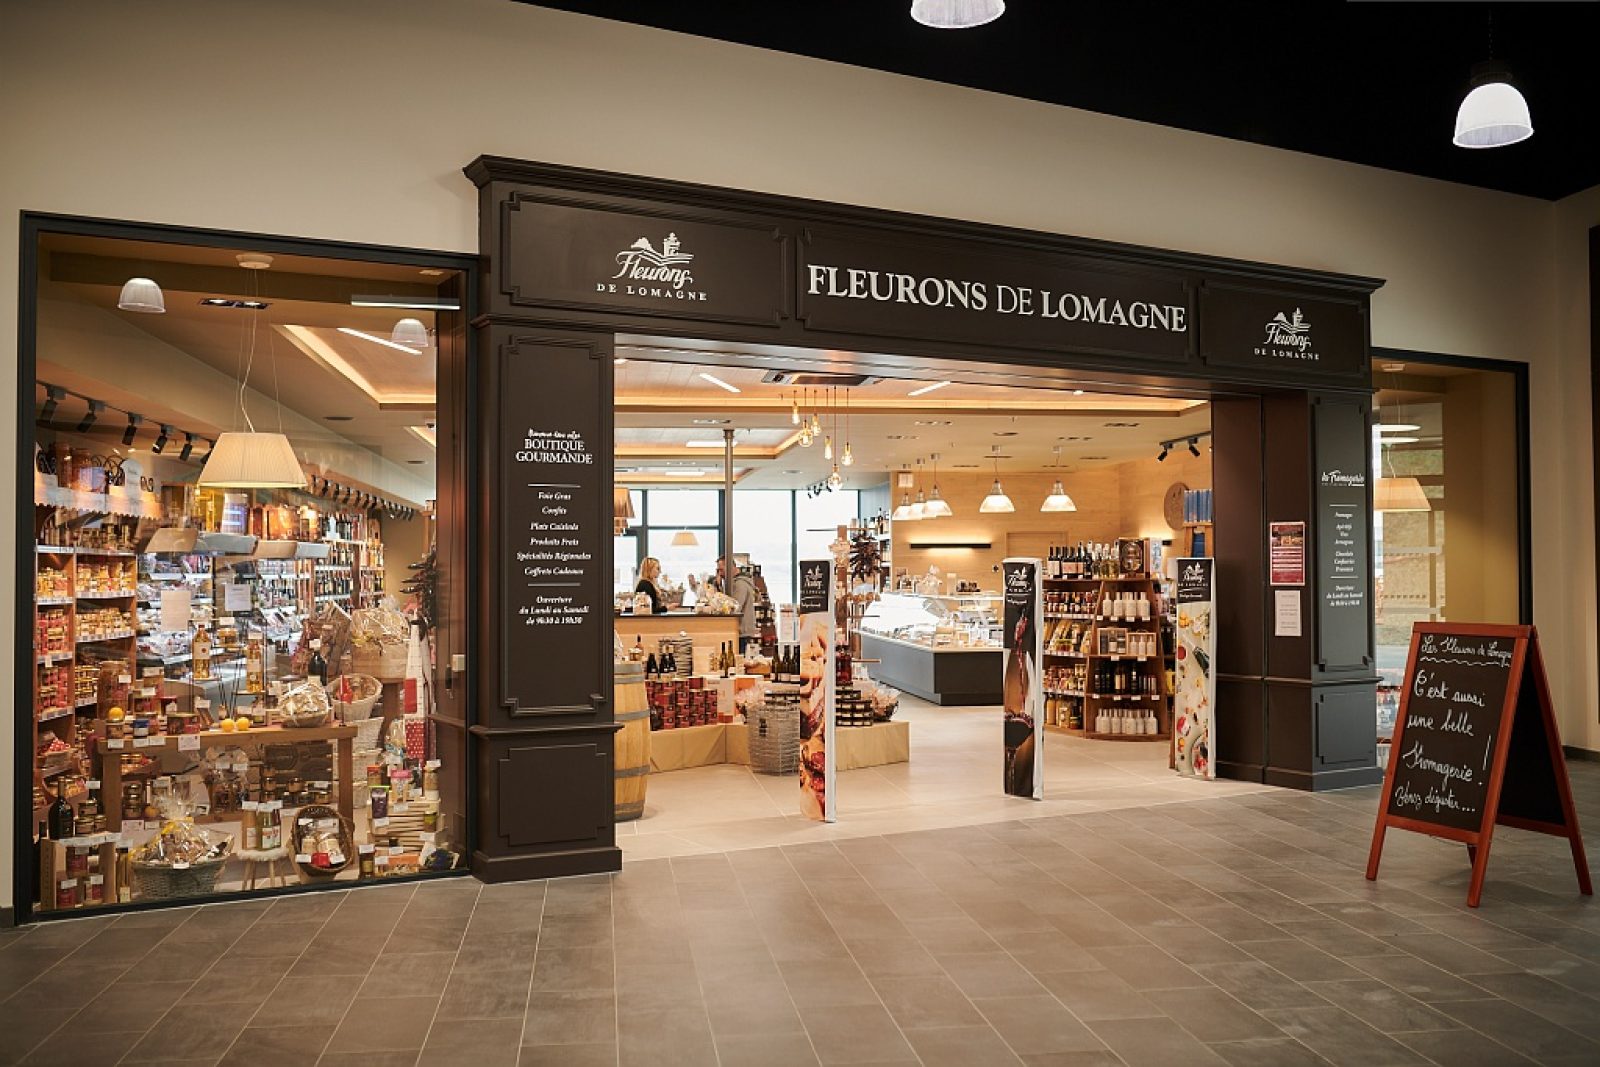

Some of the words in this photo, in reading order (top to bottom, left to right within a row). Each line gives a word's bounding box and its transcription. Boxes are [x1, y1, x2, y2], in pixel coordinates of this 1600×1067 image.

[611, 250, 694, 290] Fleurons
[596, 282, 617, 293] DE
[626, 285, 707, 301] LOMAGNE
[807, 263, 988, 311] FLEURONS
[996, 284, 1034, 315] DE
[1040, 290, 1187, 332] LOMAGNE
[1263, 322, 1312, 352] Fleurons
[1254, 347, 1267, 356] DE
[1272, 349, 1320, 360] LOMAGNE
[524, 438, 585, 452] BOUTIQUE
[515, 451, 593, 465] GOURMANDE
[538, 491, 553, 500] Foie
[554, 491, 571, 501] Gras
[529, 537, 560, 546] Produits
[536, 595, 572, 604] Ouverture
[1414, 669, 1449, 699] C'est
[1451, 690, 1485, 707] aussi
[1407, 714, 1434, 730] une
[1440, 708, 1474, 736] belle
